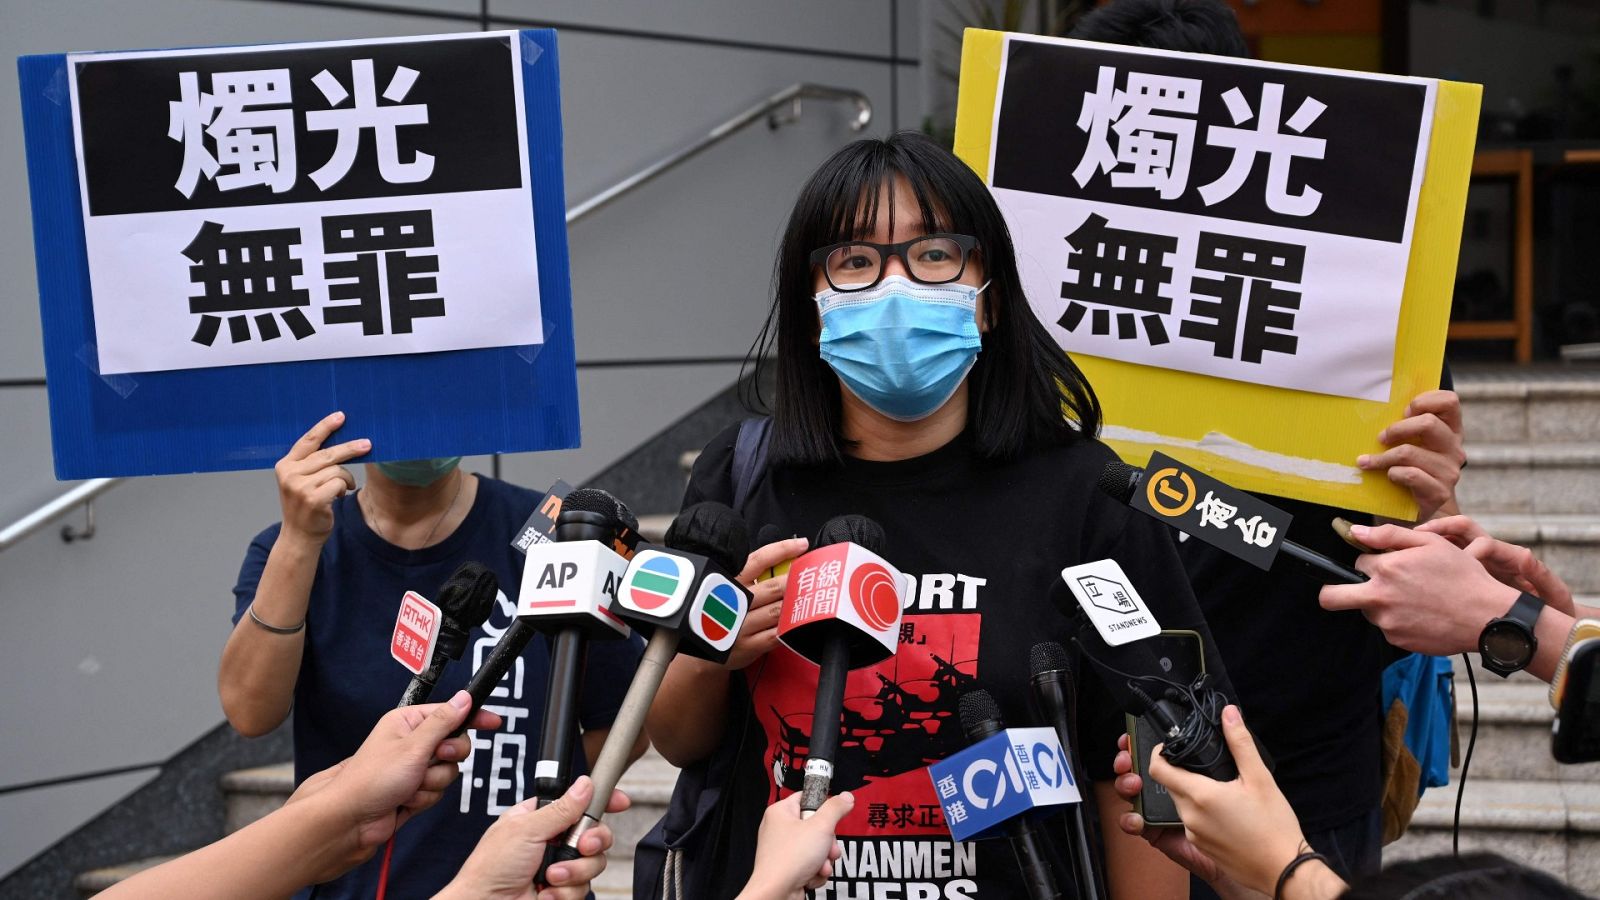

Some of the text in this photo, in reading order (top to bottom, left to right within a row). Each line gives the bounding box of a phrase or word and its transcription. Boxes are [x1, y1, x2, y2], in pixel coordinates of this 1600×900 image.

[167, 58, 435, 200] 燭光
[1071, 65, 1328, 217] 燭光
[180, 209, 446, 347] 無罪
[1056, 212, 1306, 366] 無罪
[536, 562, 578, 589] AP
[797, 560, 841, 595] 有線
[403, 604, 430, 633] RTHK
[790, 587, 838, 624] 新聞
[1108, 616, 1148, 632] STANDNEWS
[867, 803, 952, 829] 尋求正
[937, 773, 969, 826] 香港
